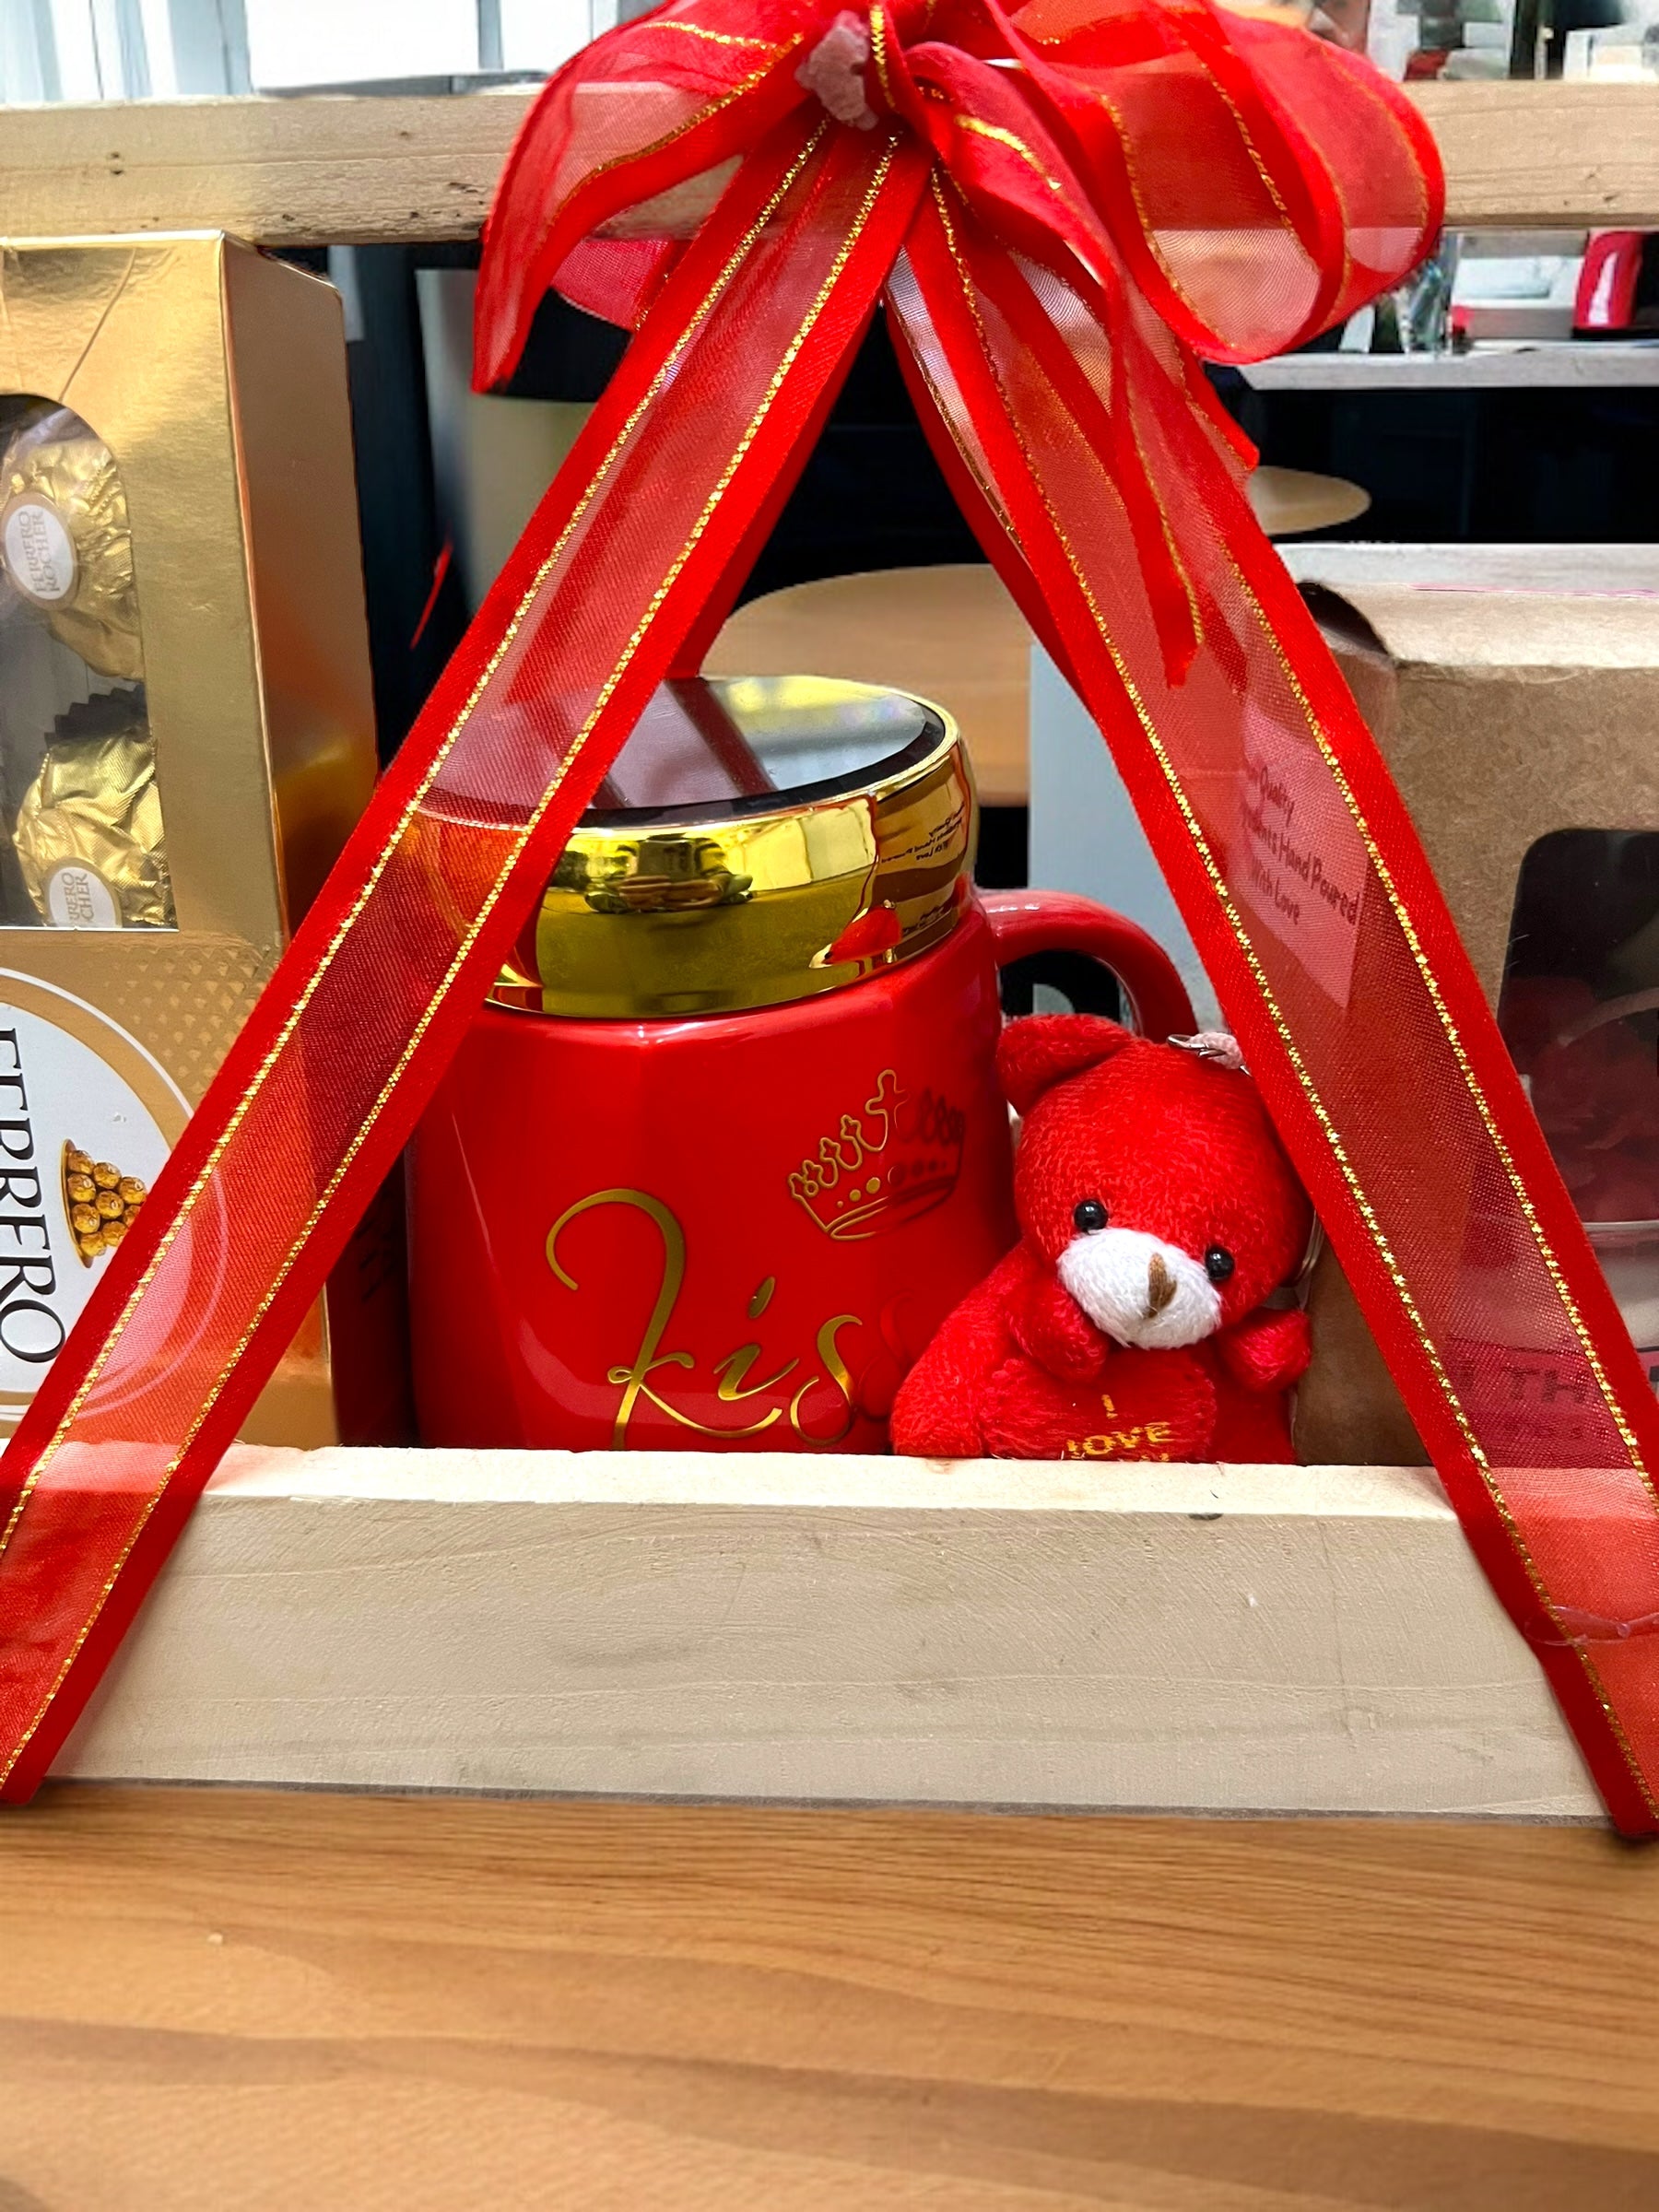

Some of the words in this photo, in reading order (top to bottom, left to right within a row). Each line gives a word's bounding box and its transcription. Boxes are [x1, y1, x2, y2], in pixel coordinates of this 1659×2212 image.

[29, 510, 60, 593] ROCHER
[75, 872, 95, 922] CHER
[1275, 877, 1300, 925] Love
[1101, 1394, 1118, 1419] I
